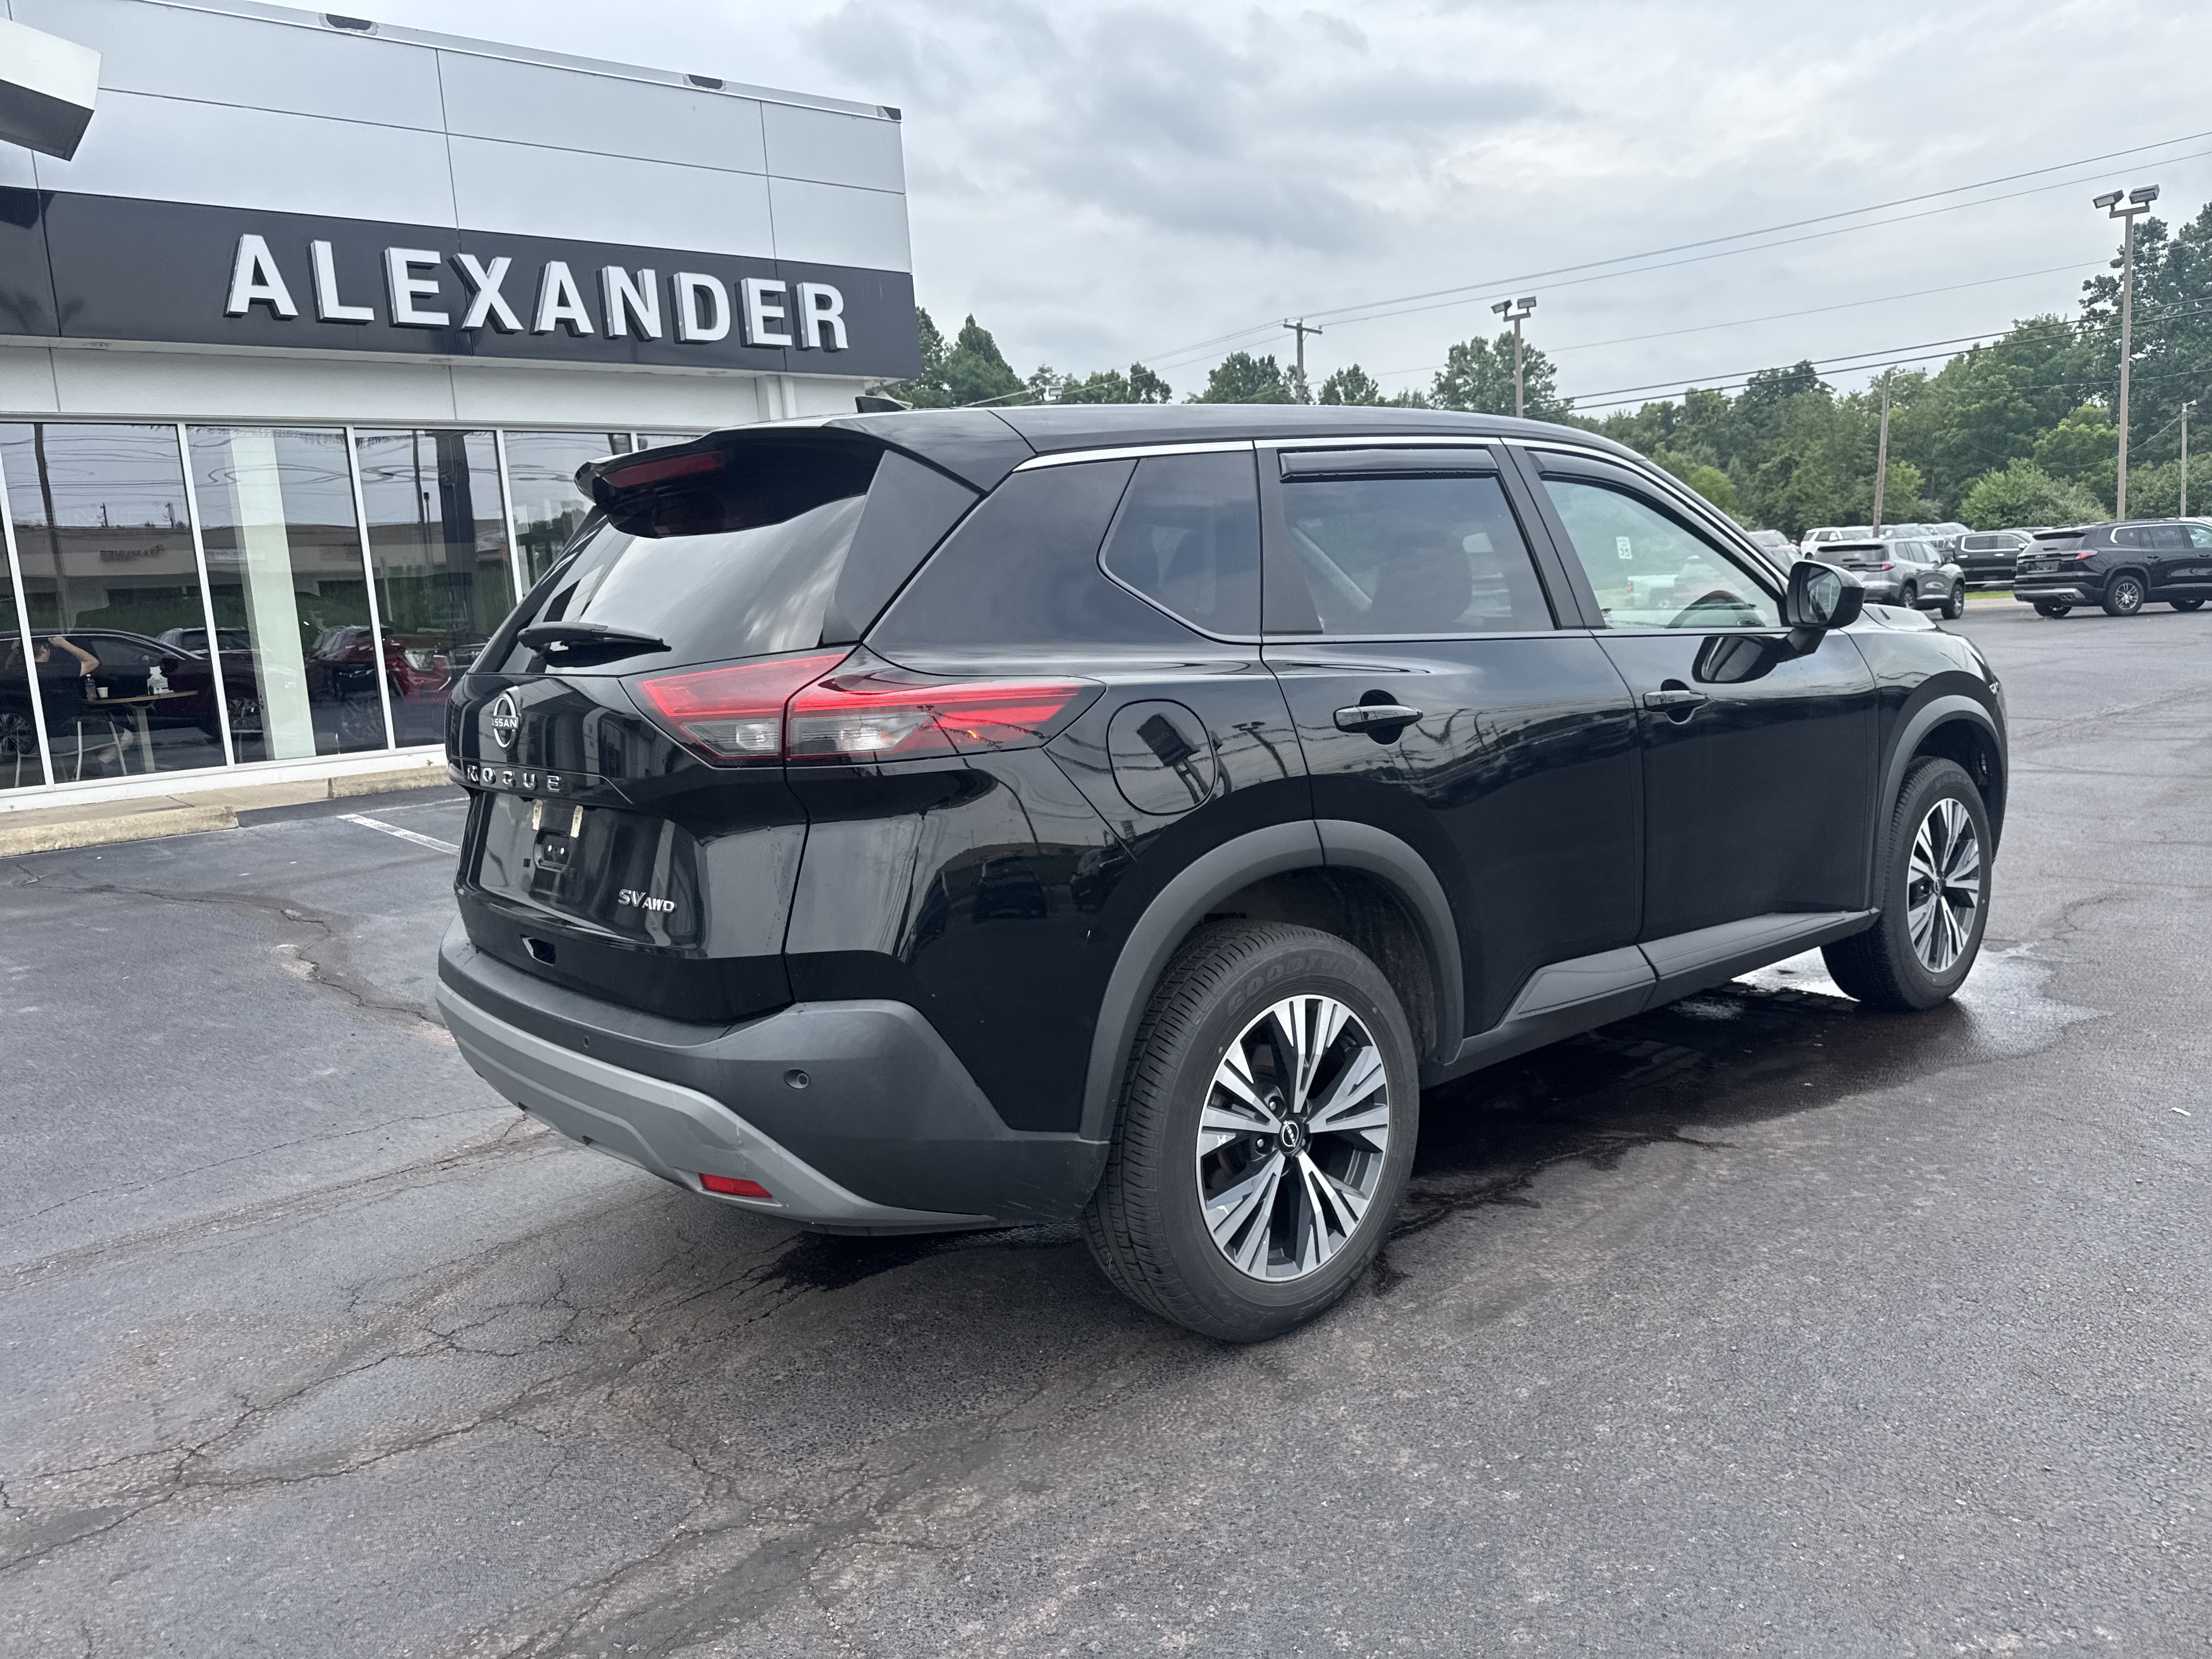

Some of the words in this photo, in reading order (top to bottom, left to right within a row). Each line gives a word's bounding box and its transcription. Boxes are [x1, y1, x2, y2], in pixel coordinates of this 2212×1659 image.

[225, 233, 849, 349] ALEXANDER
[492, 718, 517, 728] SSAN
[467, 765, 561, 793] ROGUE
